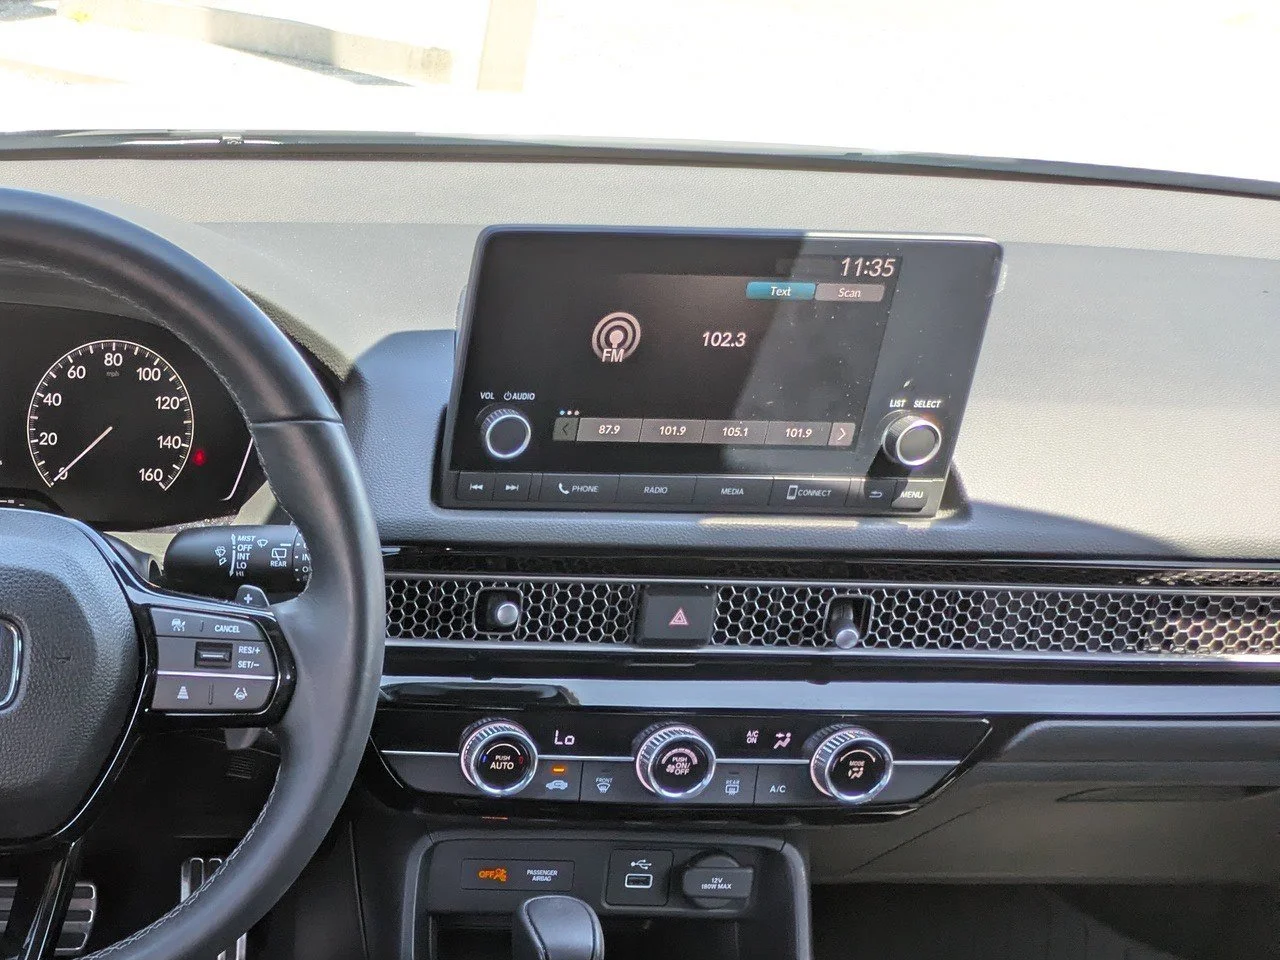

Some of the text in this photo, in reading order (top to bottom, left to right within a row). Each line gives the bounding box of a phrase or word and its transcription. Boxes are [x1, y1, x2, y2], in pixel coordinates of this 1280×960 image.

[841, 257, 895, 277] 11:35
[770, 286, 792, 297] Text
[838, 287, 861, 298] Scan
[702, 331, 747, 347] 102.3
[104, 352, 123, 366] 80
[601, 348, 625, 362] FM
[67, 365, 86, 379] 60
[136, 367, 161, 381] 100
[43, 393, 62, 407] 40
[480, 391, 495, 400] VOL
[512, 392, 536, 401] AUDIO
[155, 396, 180, 410] 120
[889, 399, 906, 408] LIST
[913, 400, 942, 408] SELECT
[598, 425, 621, 435] 87.9
[659, 426, 687, 436] 101.9
[722, 427, 749, 437] 105.1
[785, 428, 813, 438] 101.9
[39, 432, 58, 446] 20
[157, 436, 181, 449] 140
[139, 468, 163, 482] 160
[571, 485, 599, 493] PHONE
[643, 486, 668, 494] RADIO
[721, 487, 745, 495] MEDIA
[797, 488, 832, 497] CONNECT
[900, 490, 924, 499] MENU
[214, 625, 240, 633] CANCEL
[554, 730, 575, 746] Lo
[746, 730, 759, 738] A/C
[490, 762, 514, 770] AUTO
[770, 785, 787, 793] A/C
[478, 870, 495, 879] OFF
